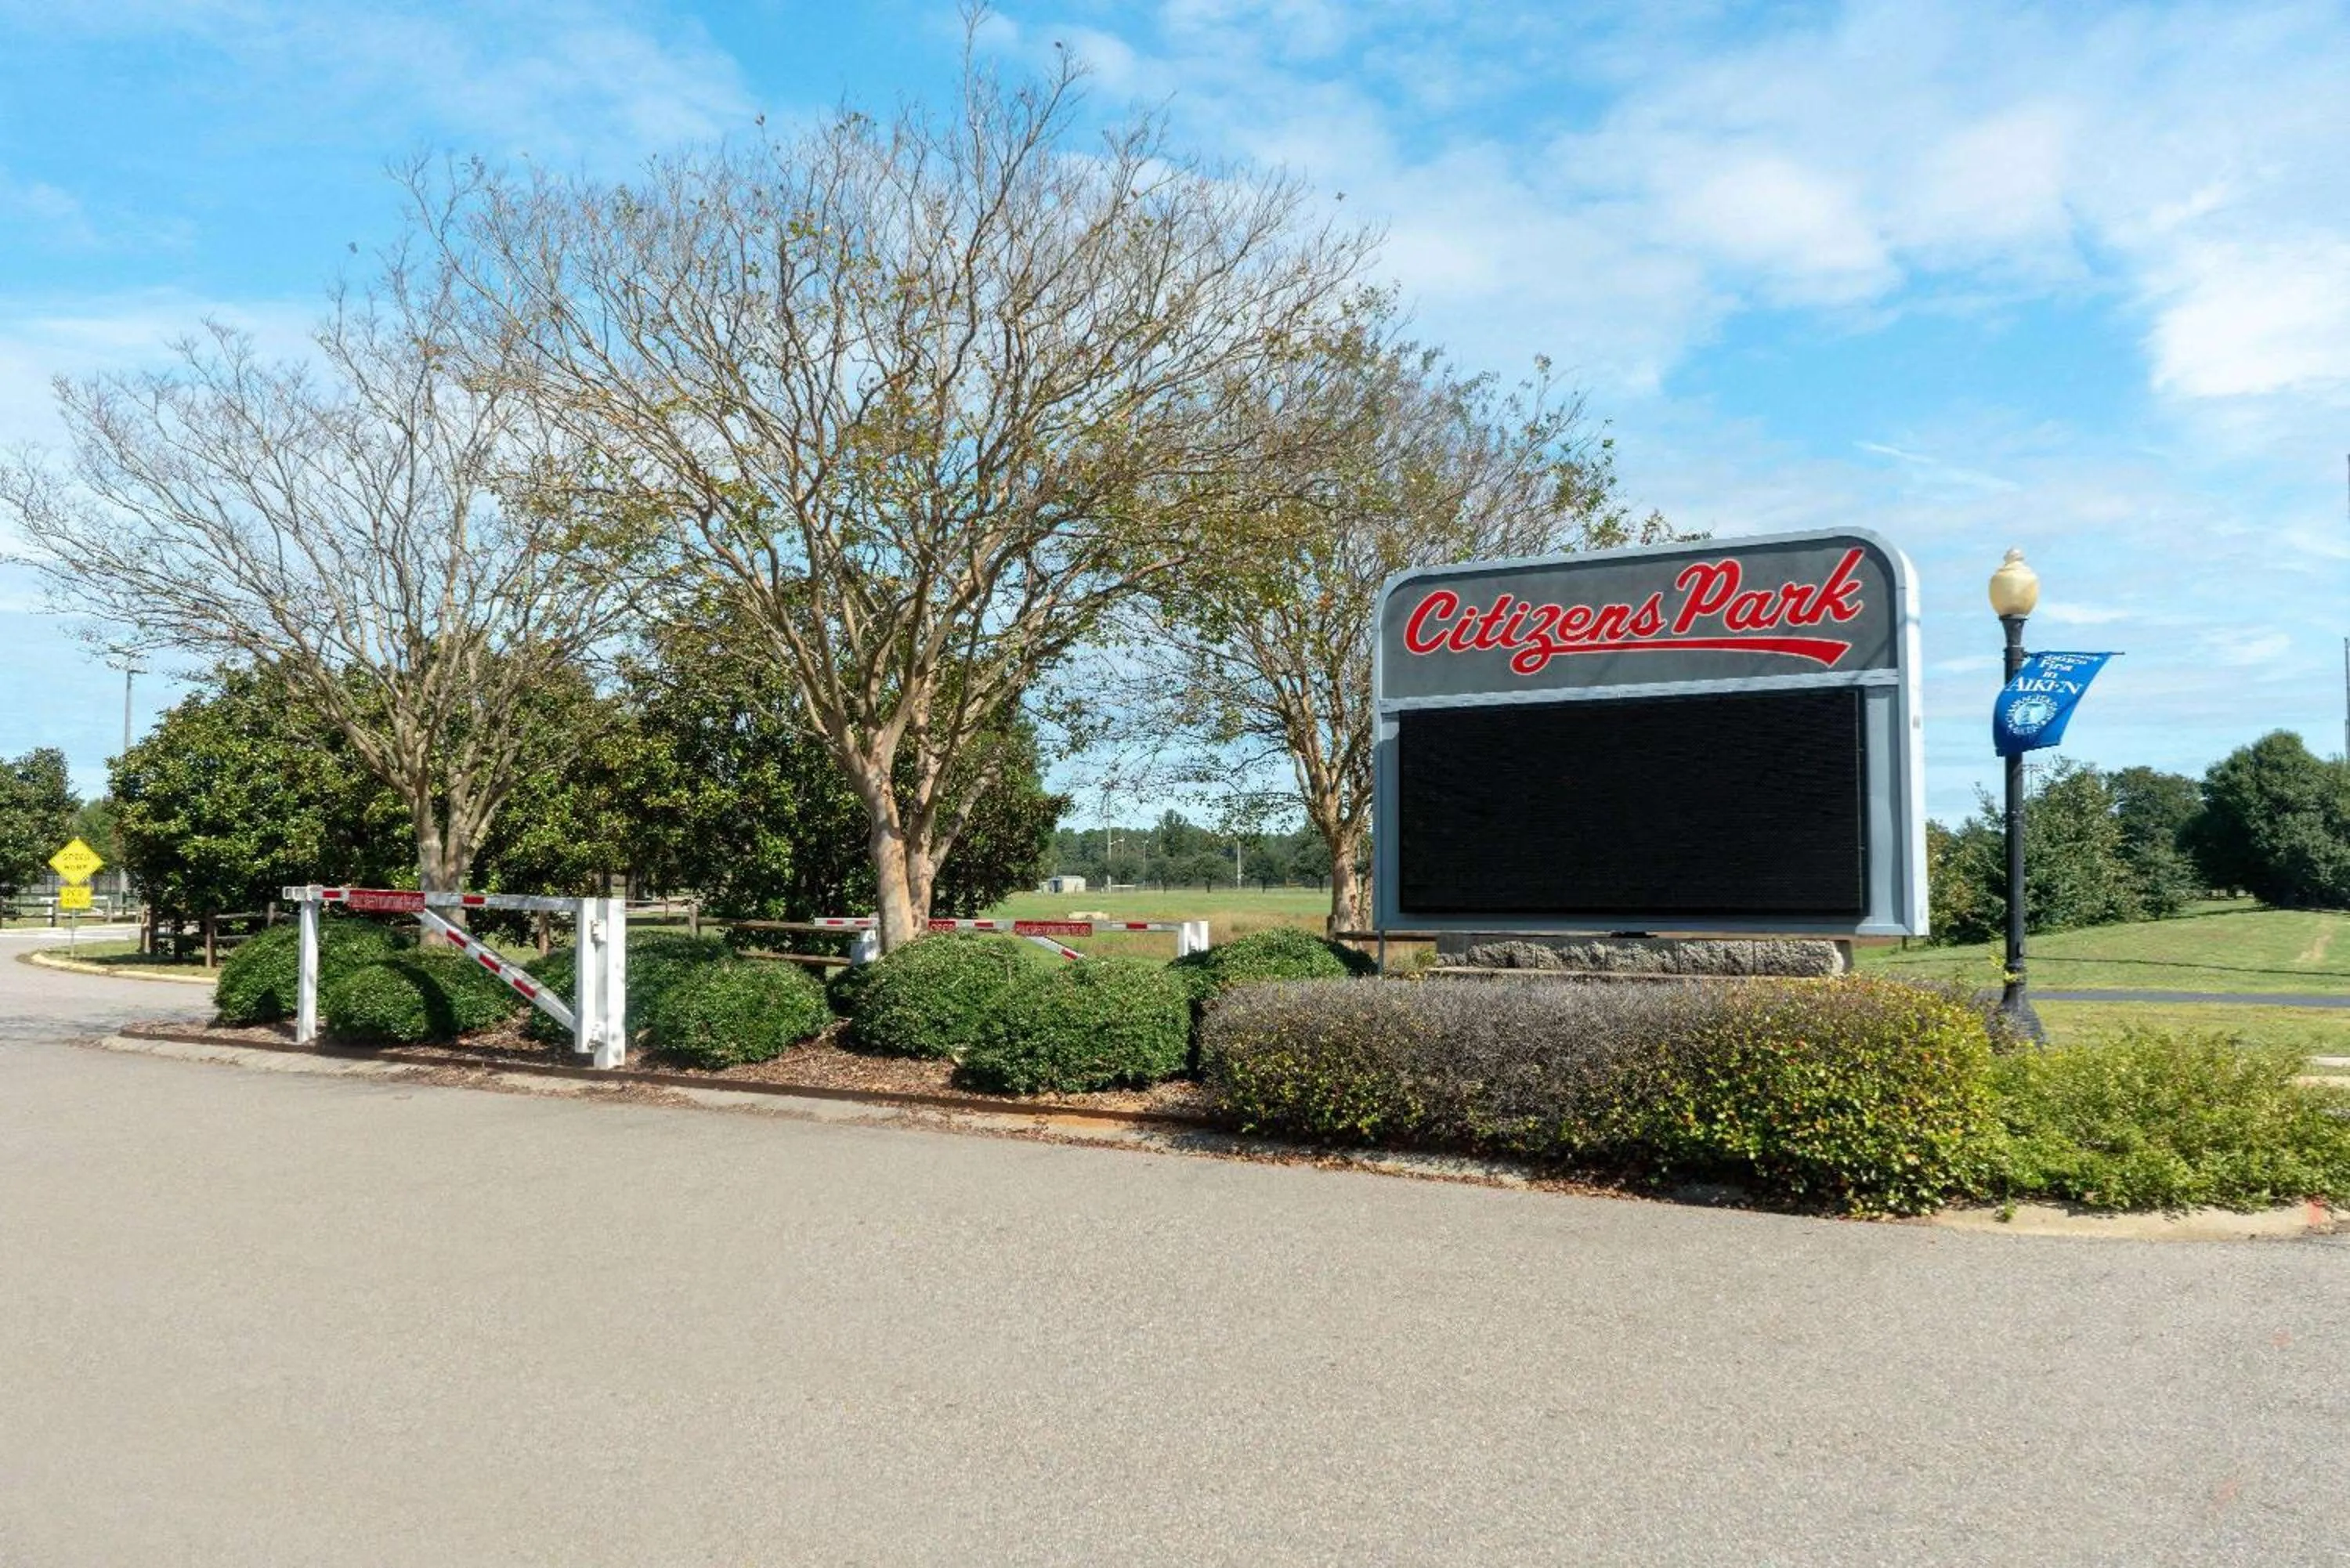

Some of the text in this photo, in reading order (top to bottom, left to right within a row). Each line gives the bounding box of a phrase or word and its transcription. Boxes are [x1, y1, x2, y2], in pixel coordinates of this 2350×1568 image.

[1404, 546, 1866, 675] Citizens Park
[2005, 676, 2084, 695] AIKEN
